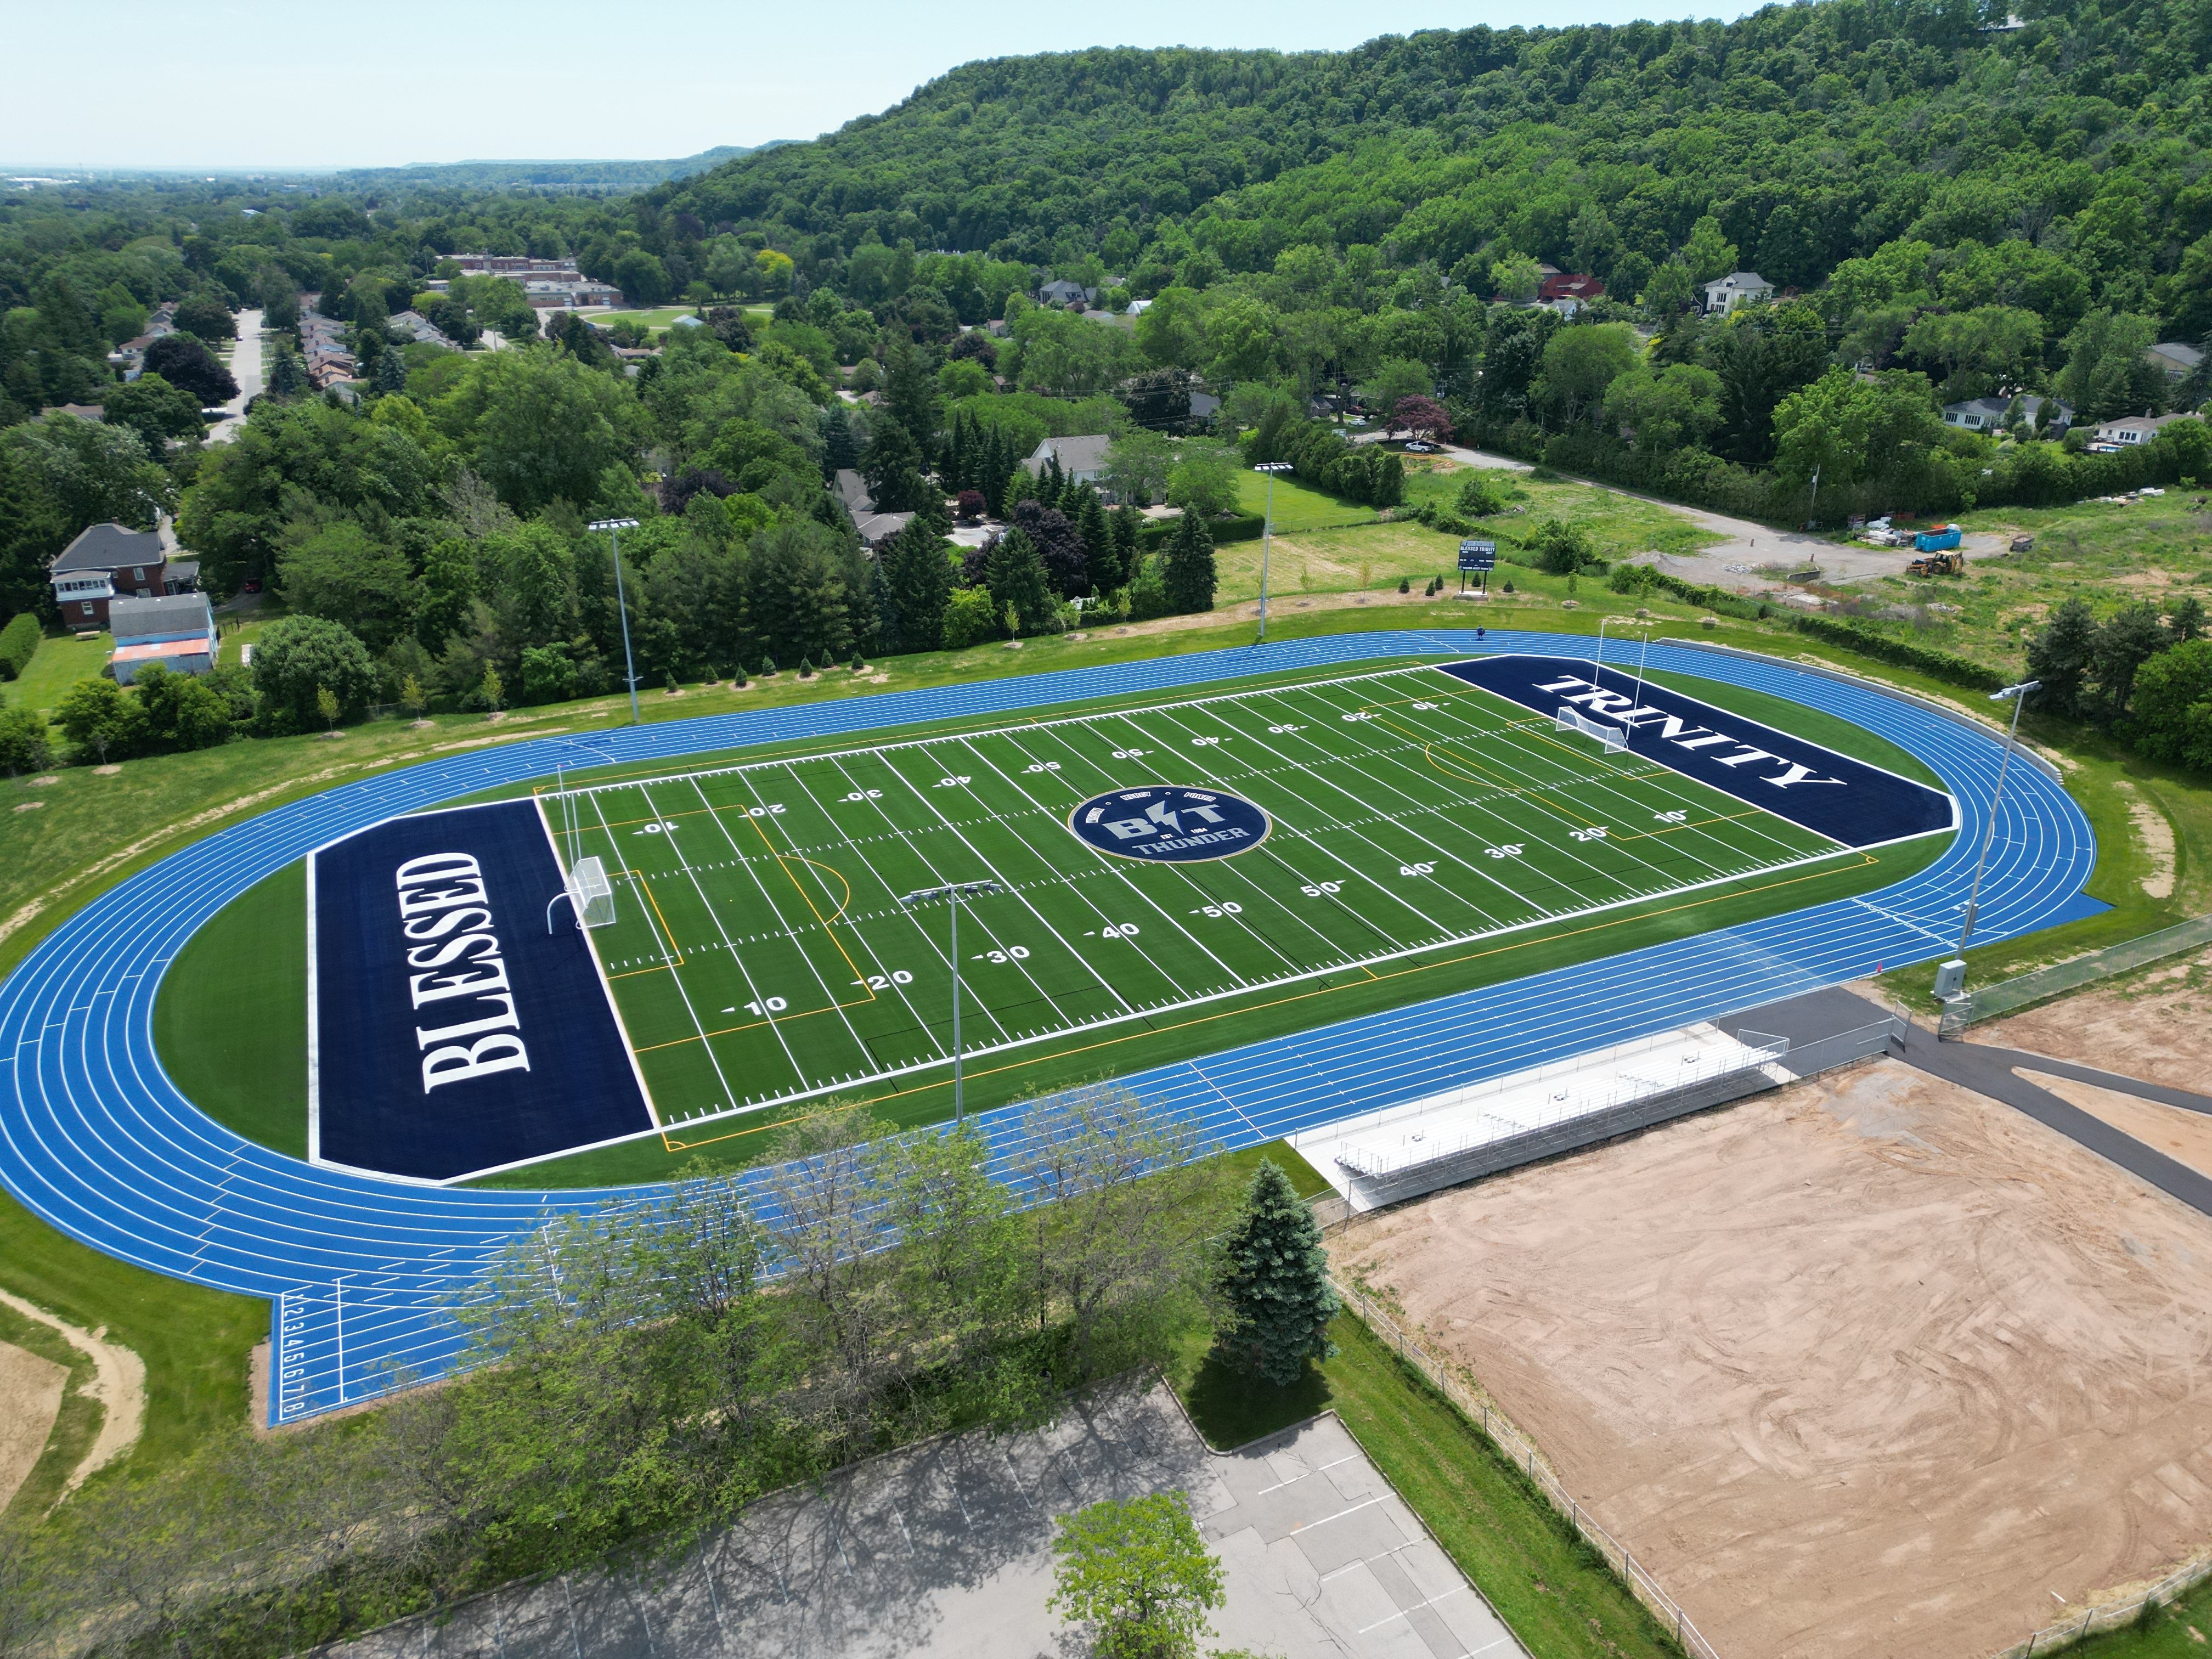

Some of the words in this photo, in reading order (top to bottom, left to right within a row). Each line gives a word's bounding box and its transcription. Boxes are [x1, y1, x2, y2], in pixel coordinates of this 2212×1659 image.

[1533, 675, 1847, 789] TRINITY
[1654, 810, 1687, 823] 10
[1131, 827, 1251, 855] THUNDER
[1570, 827, 1605, 842] 20
[1484, 844, 1520, 859] 30
[1399, 863, 1432, 878] 40
[1300, 882, 1341, 898] 50
[1204, 901, 1243, 918] 50
[1102, 923, 1140, 940] 40
[986, 945, 1031, 964] 30
[396, 853, 531, 1094] BLESSED
[867, 970, 913, 990] 20
[743, 997, 787, 1015] 10
[284, 1308, 304, 1317] 2
[284, 1323, 304, 1331] 3
[284, 1352, 304, 1363] 5
[284, 1369, 304, 1379] 6
[284, 1402, 304, 1413] 8
